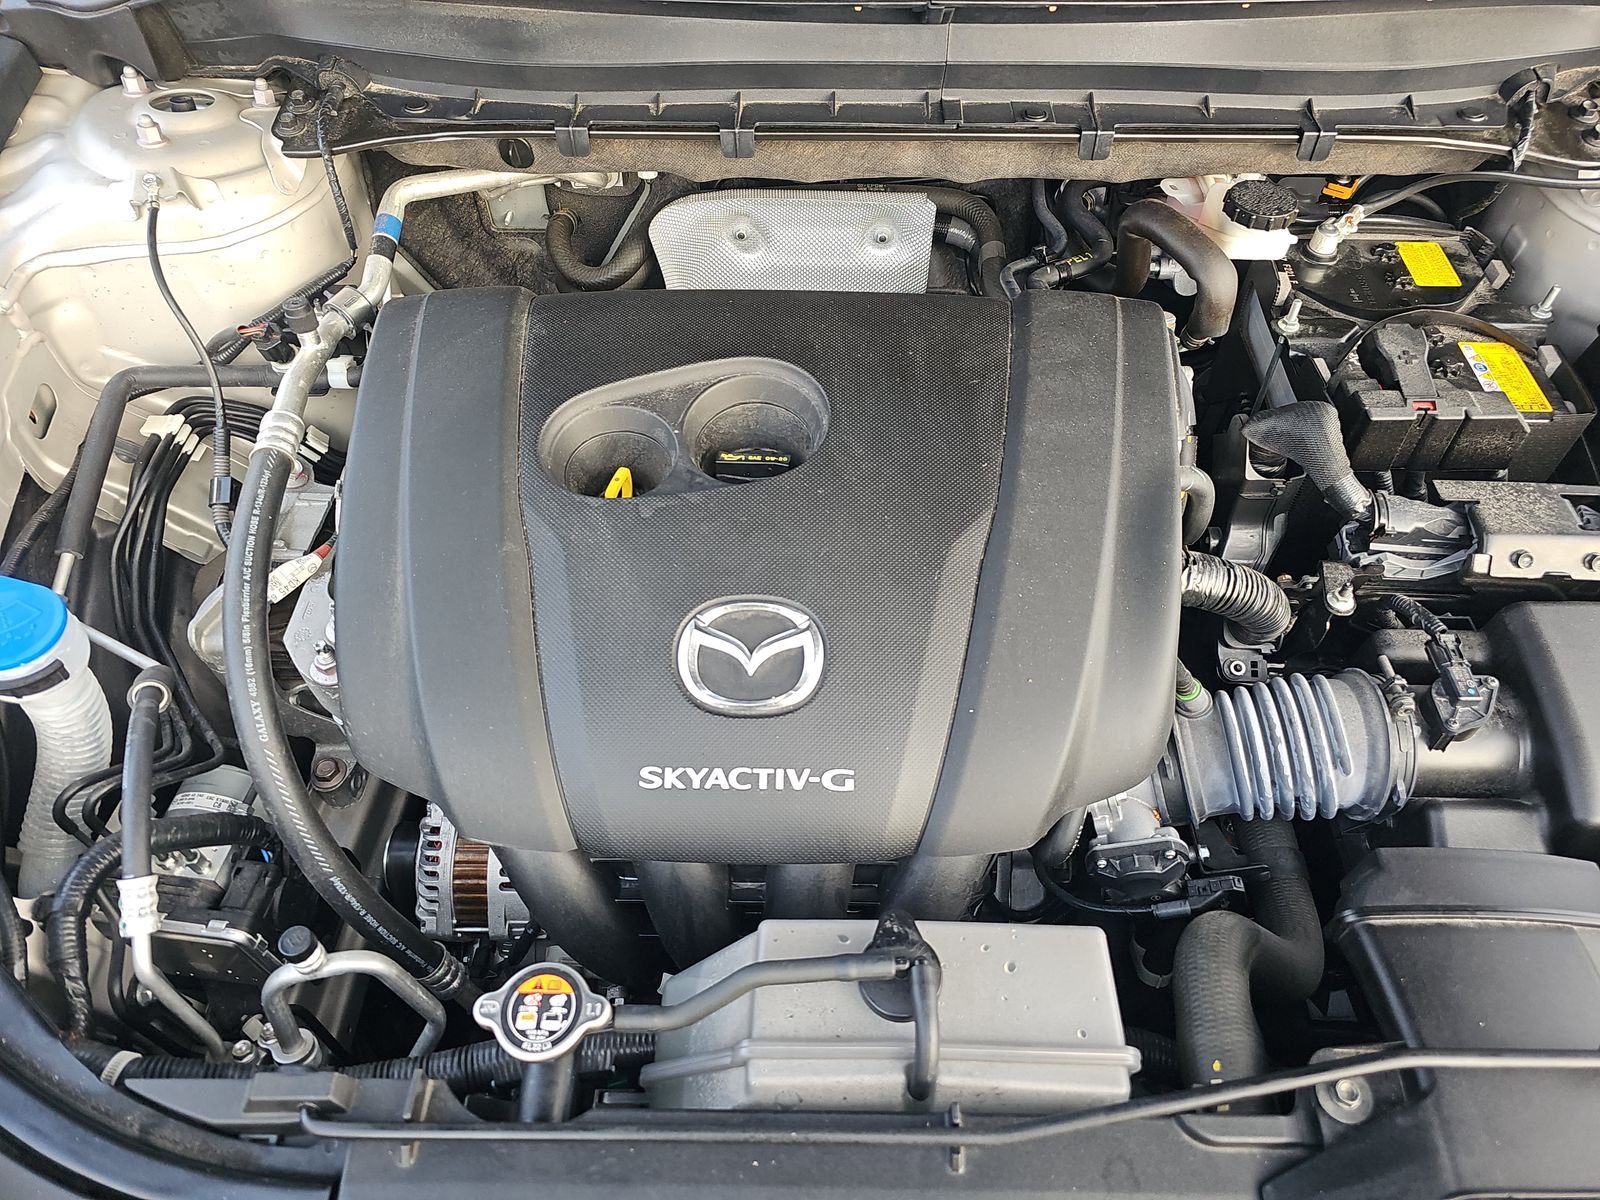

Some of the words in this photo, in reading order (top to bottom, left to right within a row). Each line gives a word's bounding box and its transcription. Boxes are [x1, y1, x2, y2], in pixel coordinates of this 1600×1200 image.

[249, 516, 260, 535] HOSE
[245, 535, 256, 567] SUCTION
[242, 567, 252, 581] A/C
[243, 645, 256, 675] (16mm)
[250, 699, 269, 742] GALAXY
[638, 765, 855, 792] SKYACTIV-G
[363, 913, 380, 929] HOSE
[377, 925, 399, 945] SUCTION
